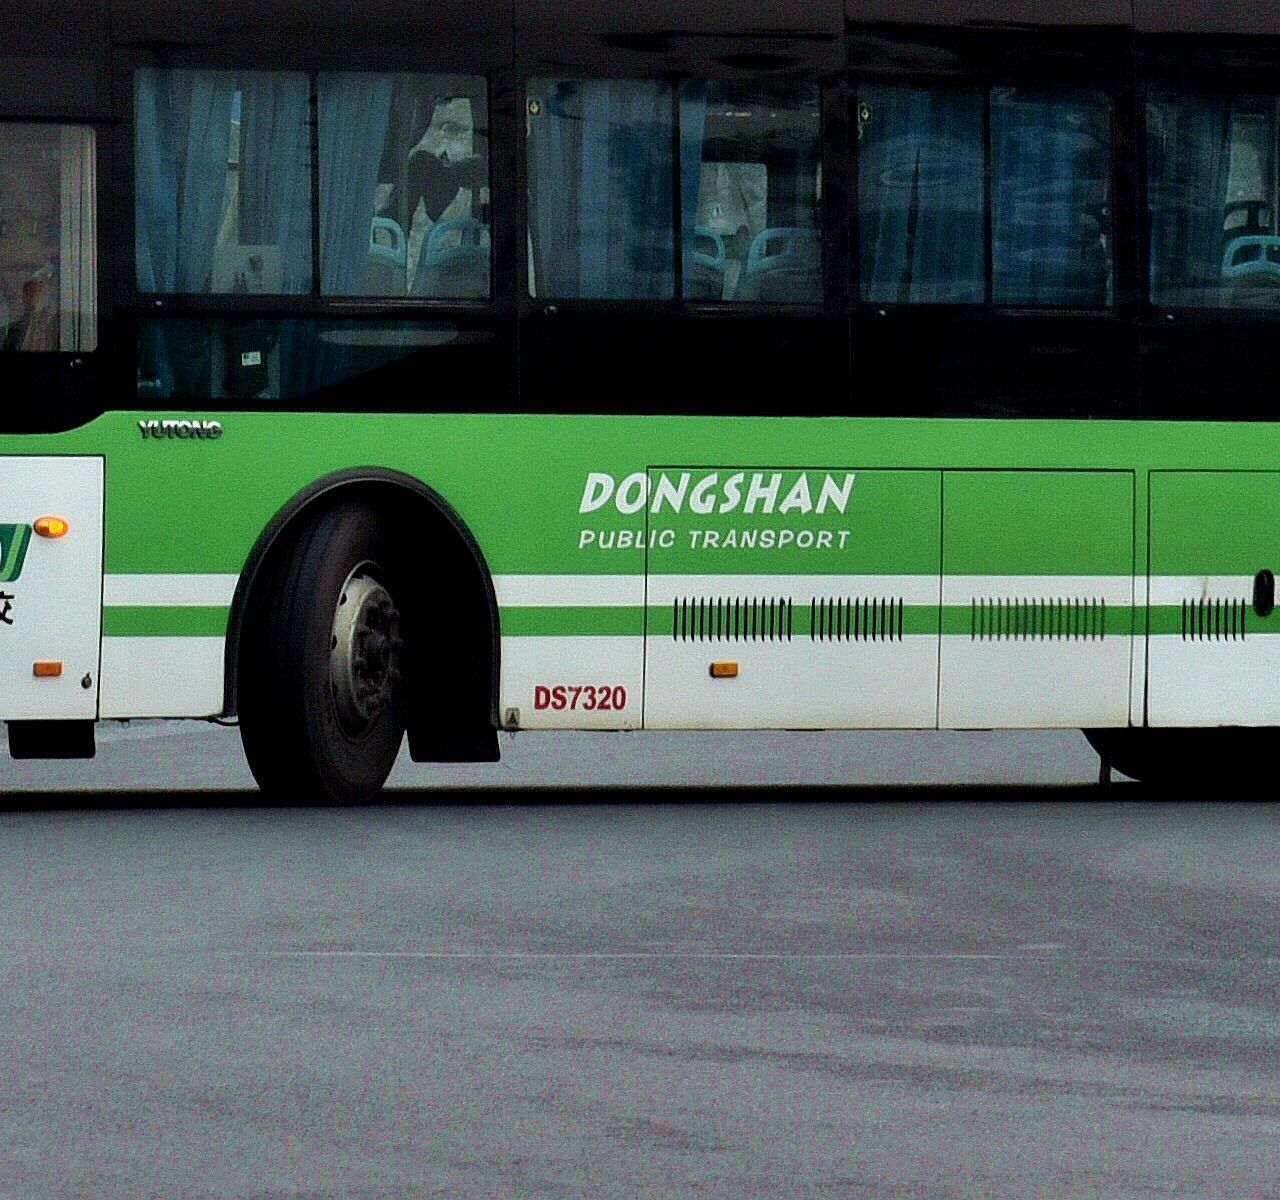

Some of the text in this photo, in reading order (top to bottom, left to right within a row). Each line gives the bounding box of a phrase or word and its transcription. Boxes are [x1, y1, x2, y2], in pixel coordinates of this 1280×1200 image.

[137, 420, 223, 439] YUTONG
[578, 472, 856, 515] DONGSHAN
[578, 530, 851, 549] PUBLIC TRANSPORT
[534, 685, 627, 711] DS7320
